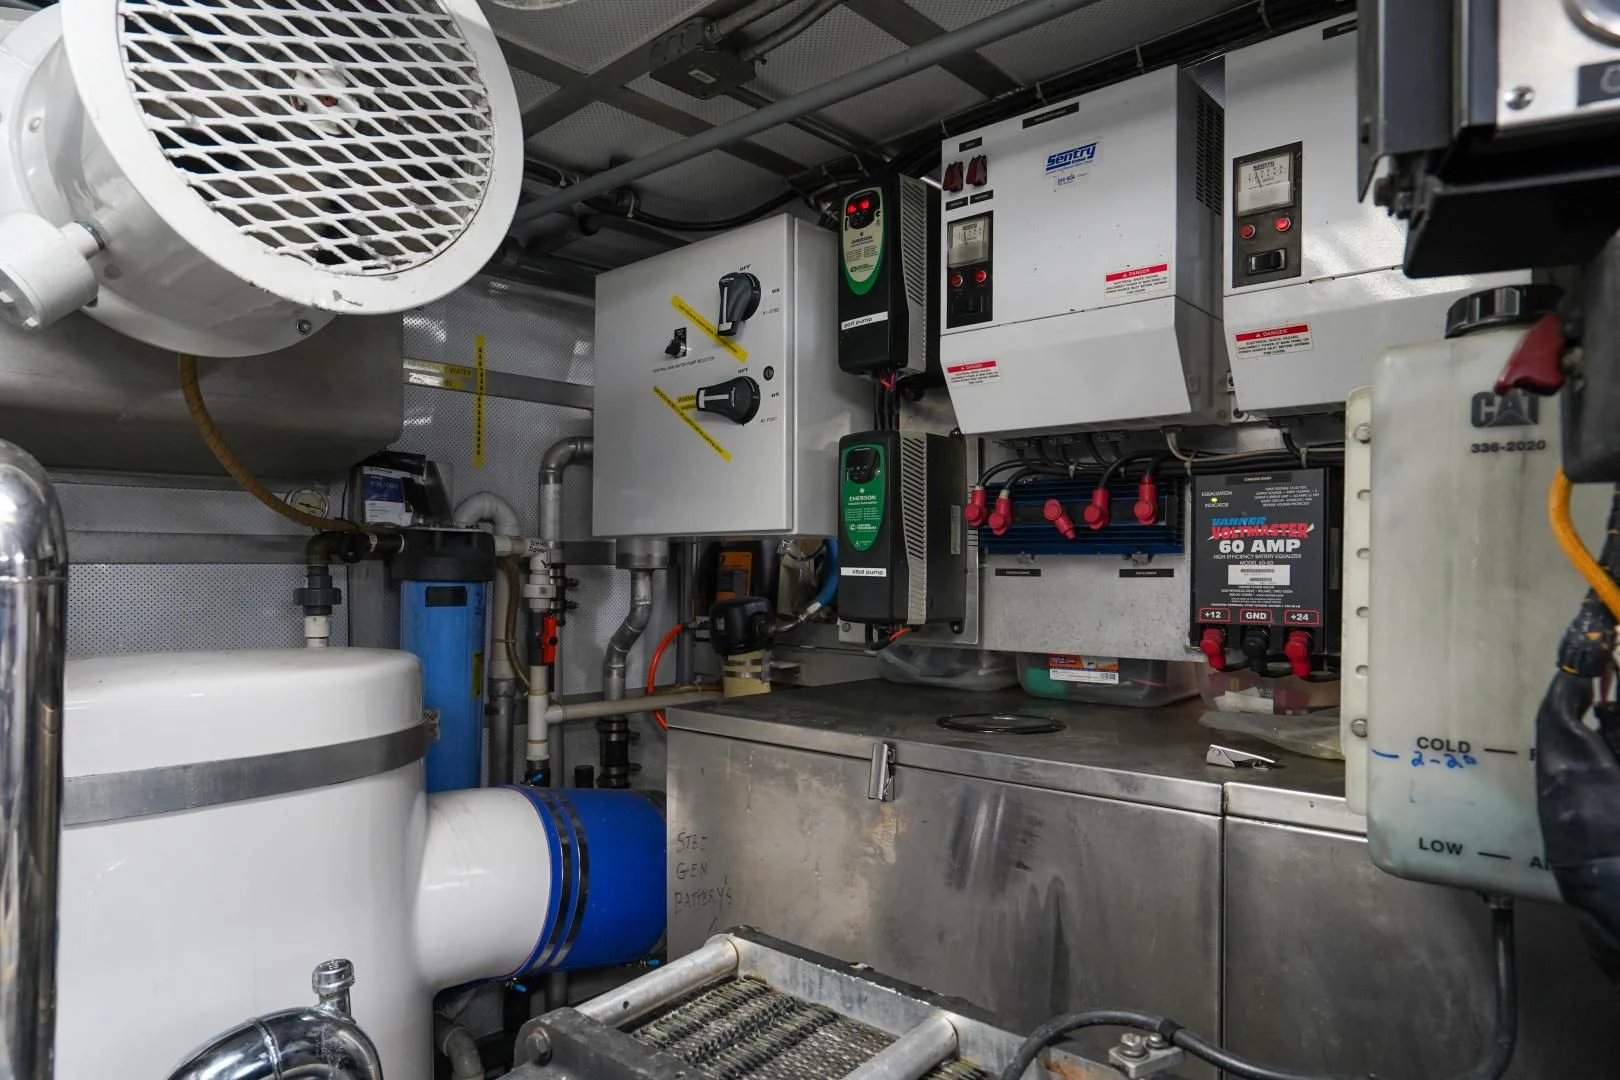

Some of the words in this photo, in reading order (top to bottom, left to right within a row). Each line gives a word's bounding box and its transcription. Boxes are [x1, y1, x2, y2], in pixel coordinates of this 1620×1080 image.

[1046, 145, 1096, 167] Sentry
[1128, 268, 1150, 277] DANGER
[1262, 329, 1288, 337] DANGER
[1471, 391, 1540, 428] CAT
[1211, 517, 1266, 526] VANNER
[1210, 522, 1309, 540] VOLTMASTER
[1219, 540, 1245, 553] 60
[1251, 540, 1301, 553] AMP
[1204, 611, 1222, 619] +12
[1245, 612, 1267, 620] GND
[1290, 613, 1309, 621] +24
[1416, 736, 1471, 754] COLD
[1418, 837, 1463, 856] LOW
[676, 862, 708, 880] GEN
